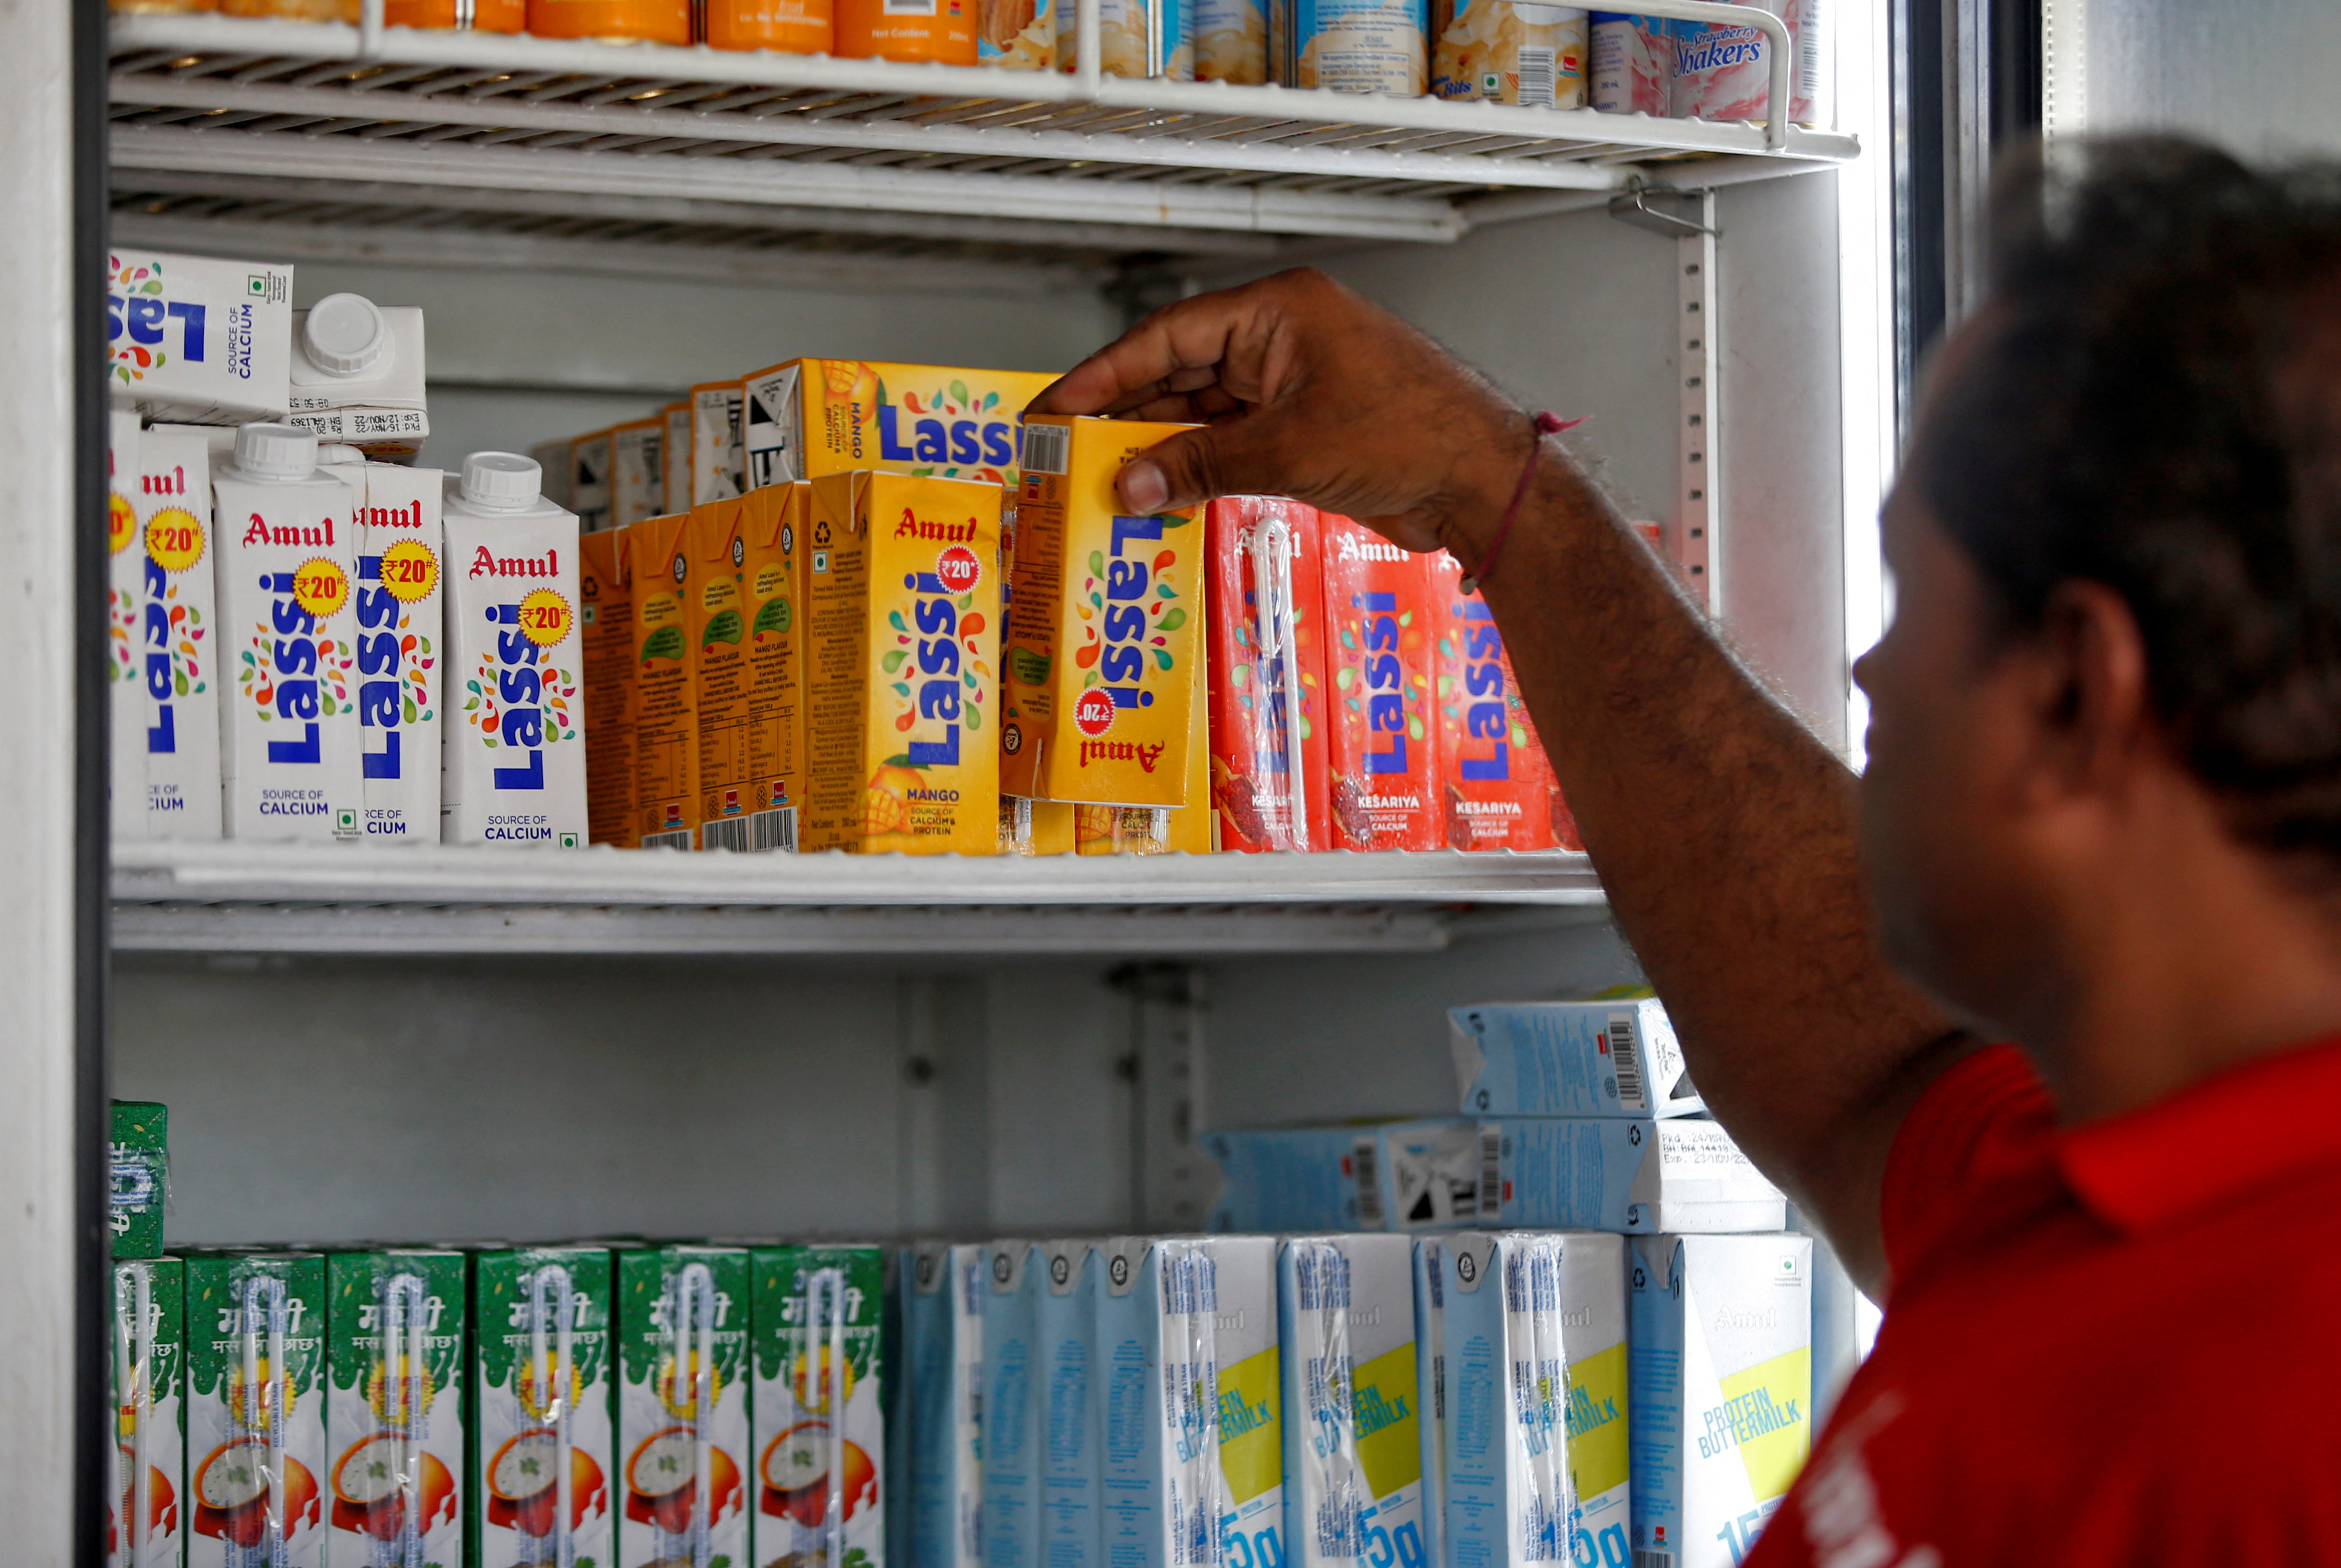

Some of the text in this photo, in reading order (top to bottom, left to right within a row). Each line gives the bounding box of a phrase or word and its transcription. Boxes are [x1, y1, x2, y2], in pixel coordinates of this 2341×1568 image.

[1689, 27, 1758, 50] Strawberry
[1673, 36, 1761, 79] Shakers
[228, 307, 237, 375] SOURCE OF
[239, 304, 252, 380] CALCIUM
[851, 402, 863, 459] MANGO
[242, 512, 335, 549] Amul
[894, 507, 976, 542] Amul
[1234, 527, 1301, 559] Al
[469, 545, 559, 581] Amul
[1101, 515, 1163, 709] Lassi
[755, 644, 771, 654] MANGO
[259, 573, 321, 764] Lassi
[904, 572, 960, 766] Lassi
[1352, 592, 1408, 774] Lassi
[1452, 602, 1509, 780] Lassi
[485, 604, 544, 790] Lassi
[1080, 740, 1165, 773] Amul
[164, 785, 179, 794] OF
[262, 790, 324, 800] SOURCE OF
[907, 789, 959, 802] MANGO
[1358, 795, 1420, 808] KESARIYA
[148, 798, 184, 811] CIUM
[260, 802, 328, 815] CALCIUM
[387, 810, 402, 819] OF
[1456, 802, 1522, 815] KESARIYA
[367, 822, 406, 834] CIUM
[488, 815, 547, 825] SOURCE OF
[910, 817, 949, 825] CALCIUM
[913, 826, 951, 835] PROTEIN
[1371, 822, 1408, 831] CALCIUM
[485, 828, 551, 840] CALCIUM
[1471, 828, 1509, 837] CALCIUM
[1347, 1305, 1381, 1326] mul
[1715, 1305, 1777, 1331] Amul
[1703, 1387, 1772, 1433] PROTEIN
[1698, 1398, 1803, 1459] BUTTERMILK
[1761, 1499, 1784, 1513] PROTEI
[1717, 1508, 1764, 1568] 15
